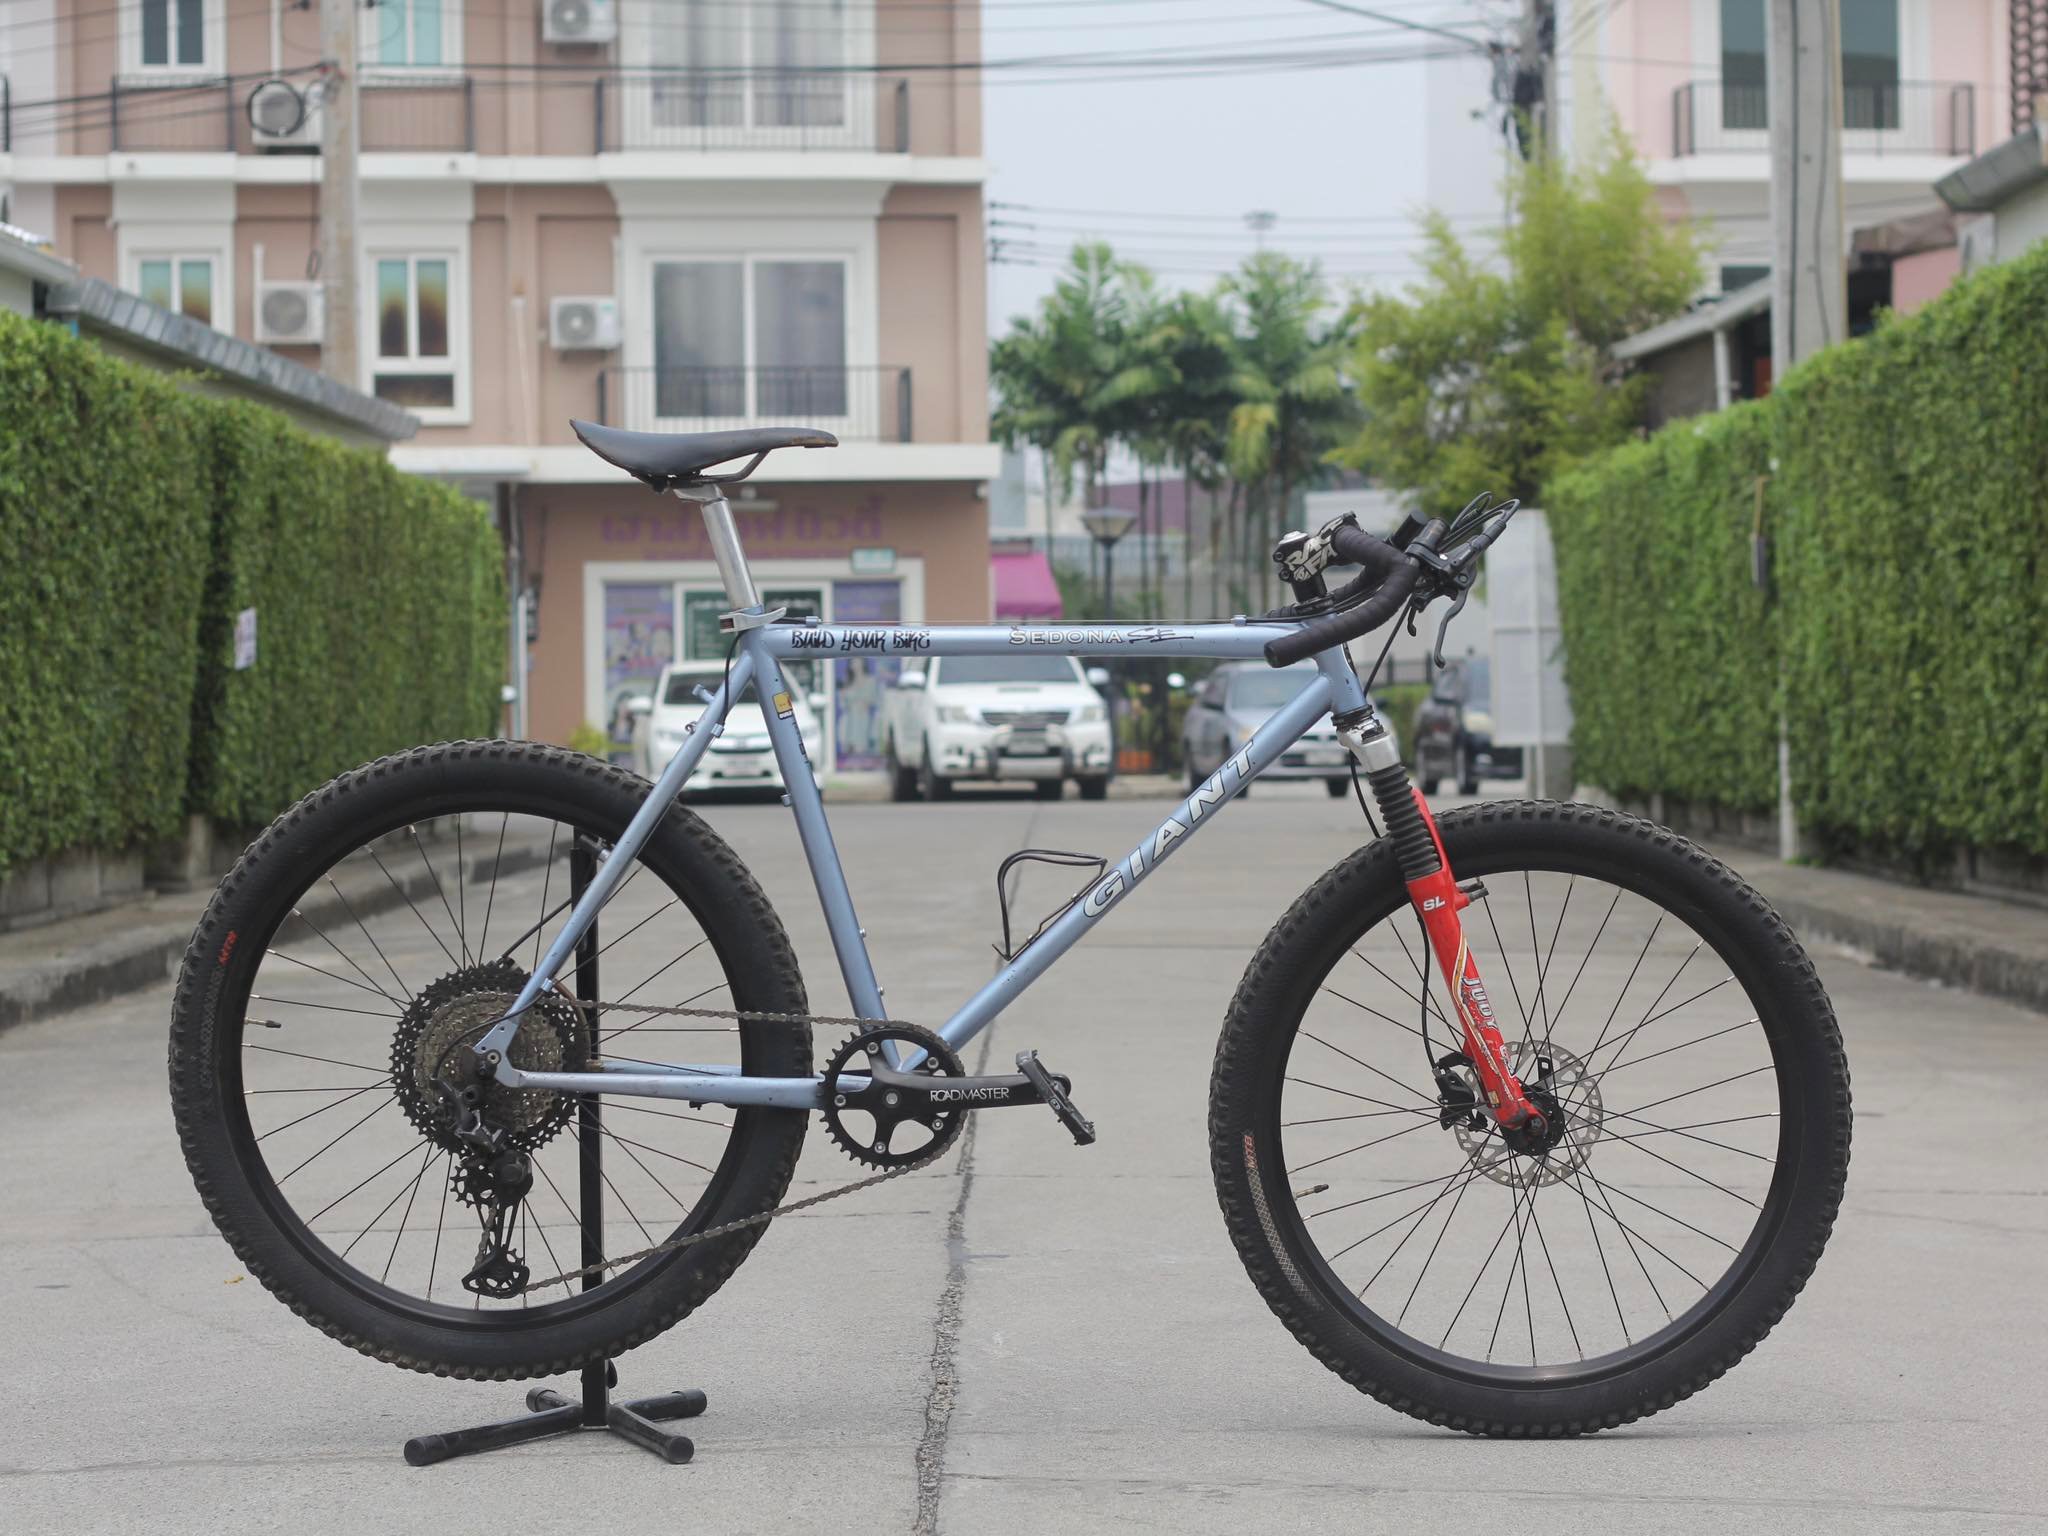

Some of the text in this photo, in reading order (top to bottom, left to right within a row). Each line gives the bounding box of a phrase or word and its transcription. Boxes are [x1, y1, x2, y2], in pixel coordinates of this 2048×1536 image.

[1009, 628, 1123, 645] SEDONA
[1083, 739, 1253, 918] GIANT
[1422, 895, 1446, 911] SL
[1461, 977, 1498, 1030] JUDY
[929, 1086, 1010, 1102] ROADMASTER
